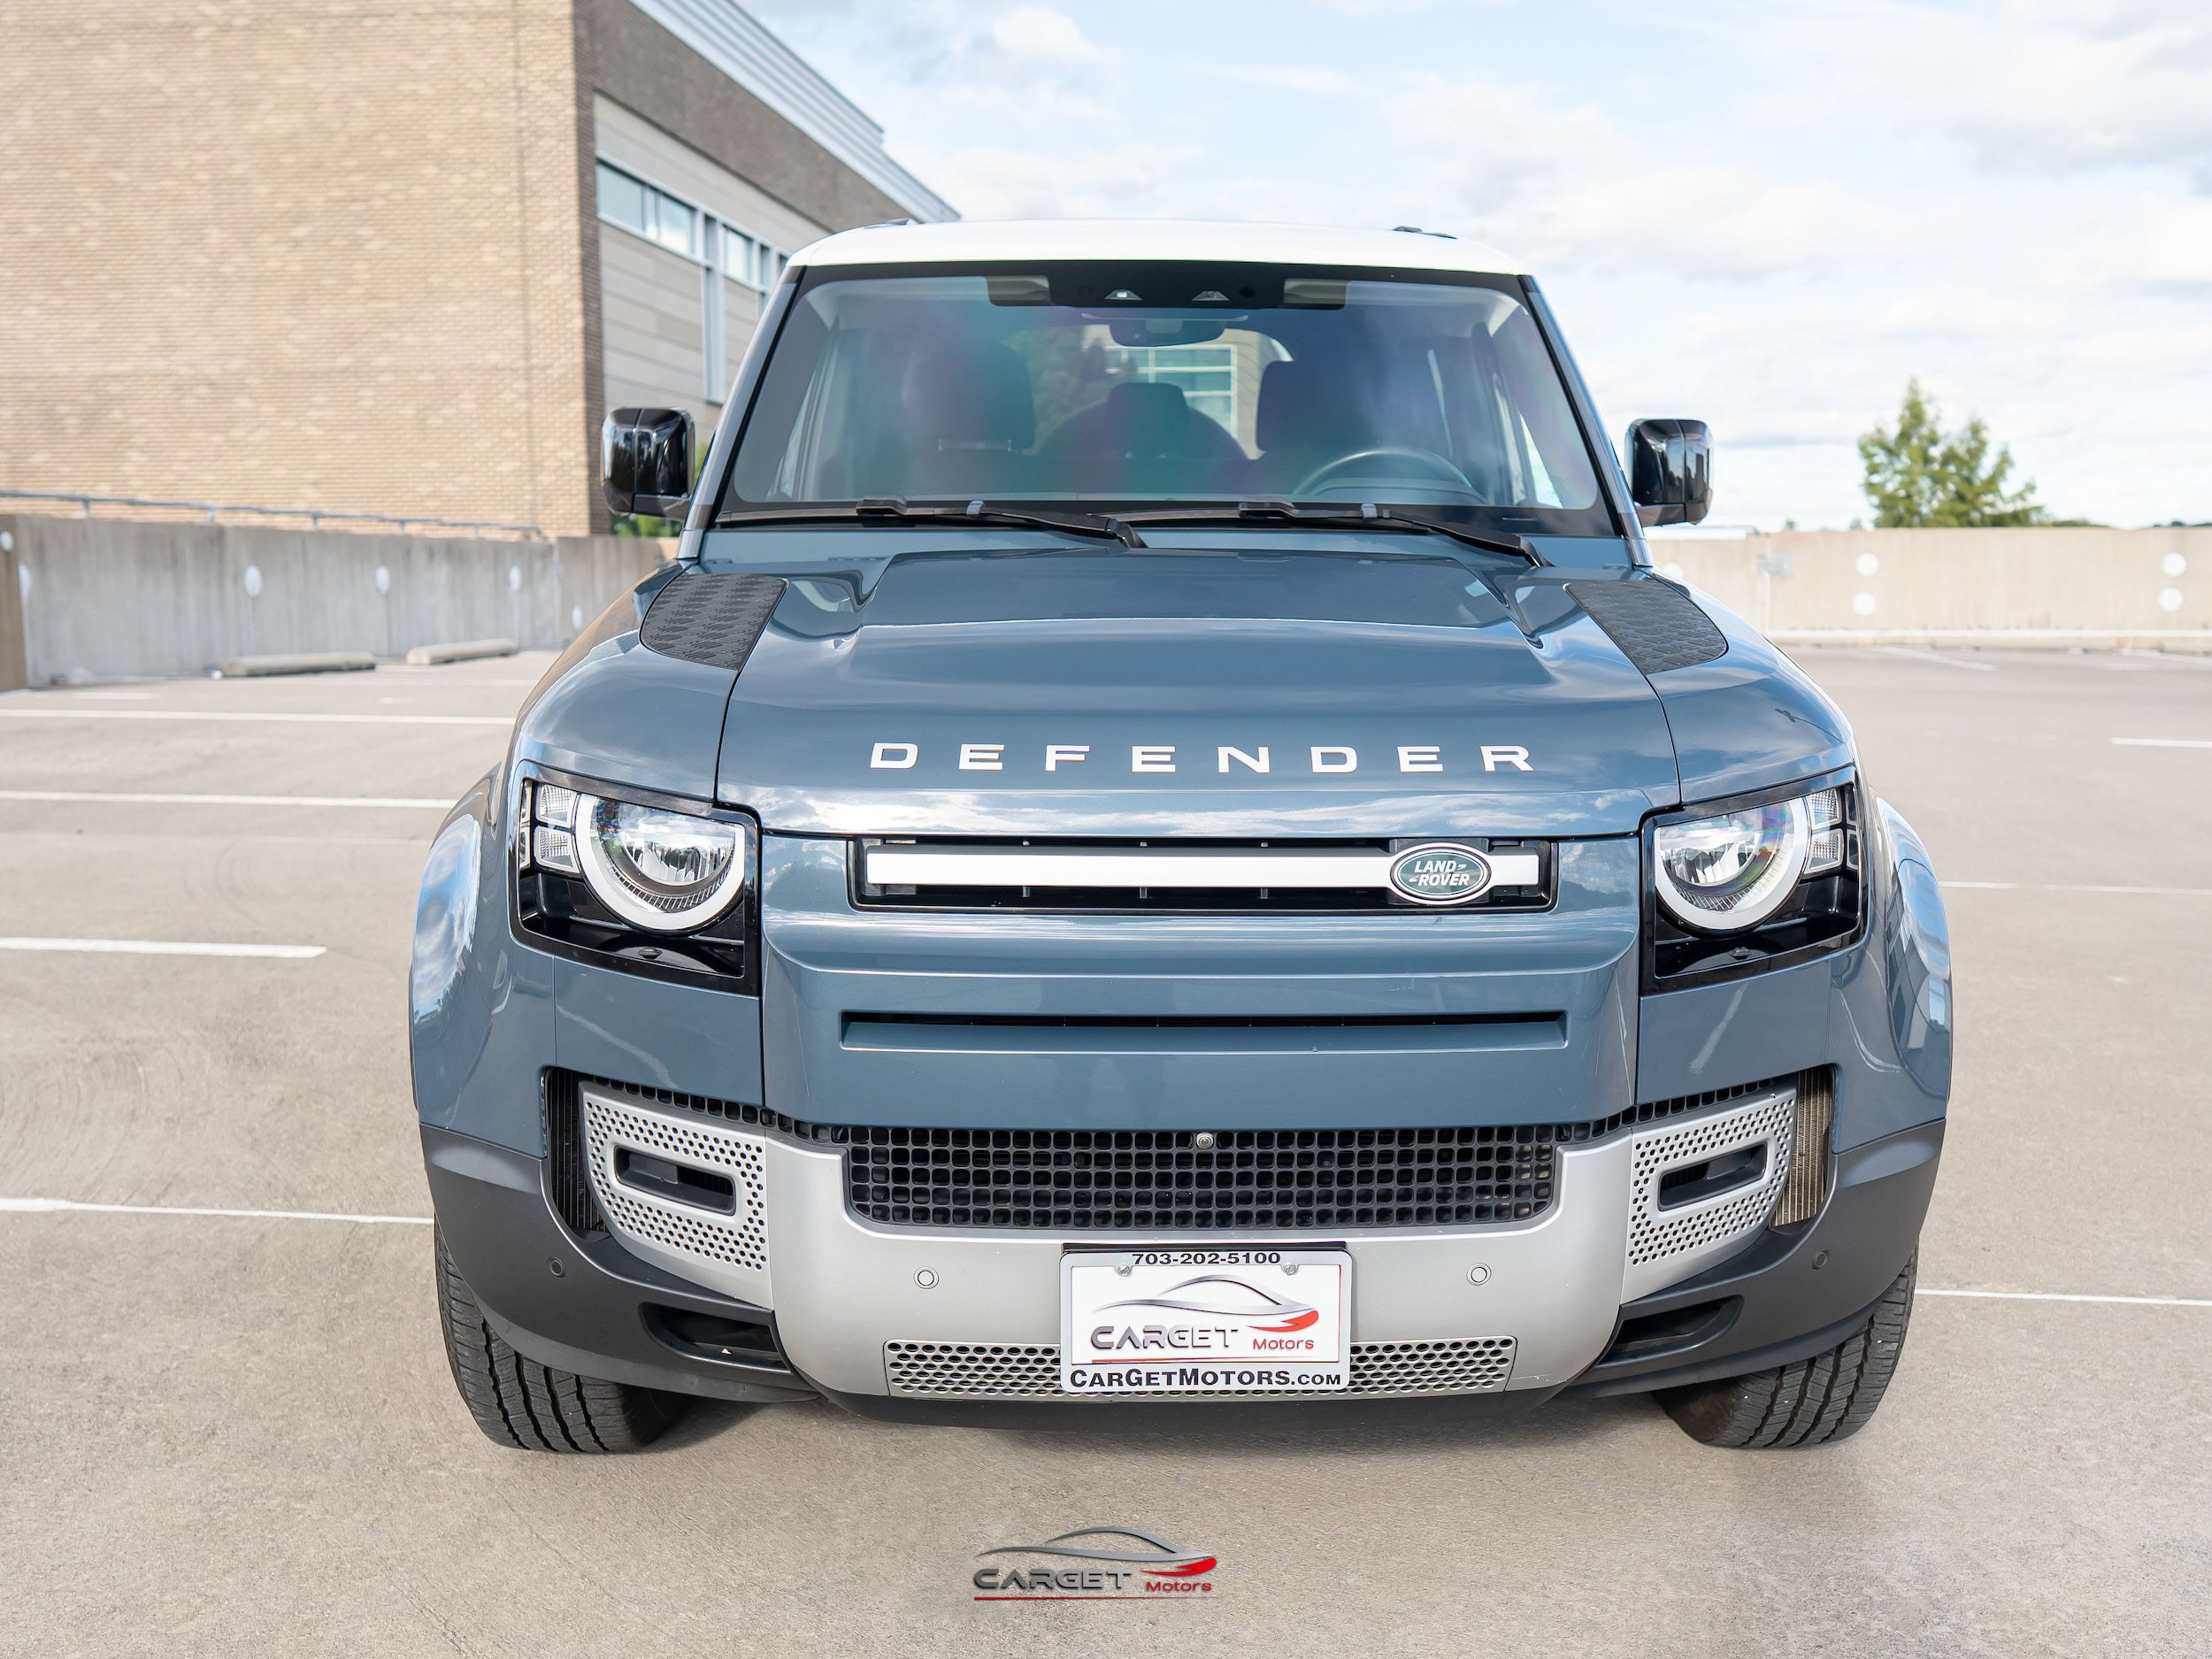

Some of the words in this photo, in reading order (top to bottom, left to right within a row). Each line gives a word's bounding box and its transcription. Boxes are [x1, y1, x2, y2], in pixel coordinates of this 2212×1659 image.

[870, 742, 1535, 773] DEFENDER
[1417, 873, 1471, 887] ROVER
[1132, 1252, 1281, 1265] 703-202-5100
[1090, 1325, 1239, 1349] CARGET
[1252, 1338, 1315, 1351] Motors
